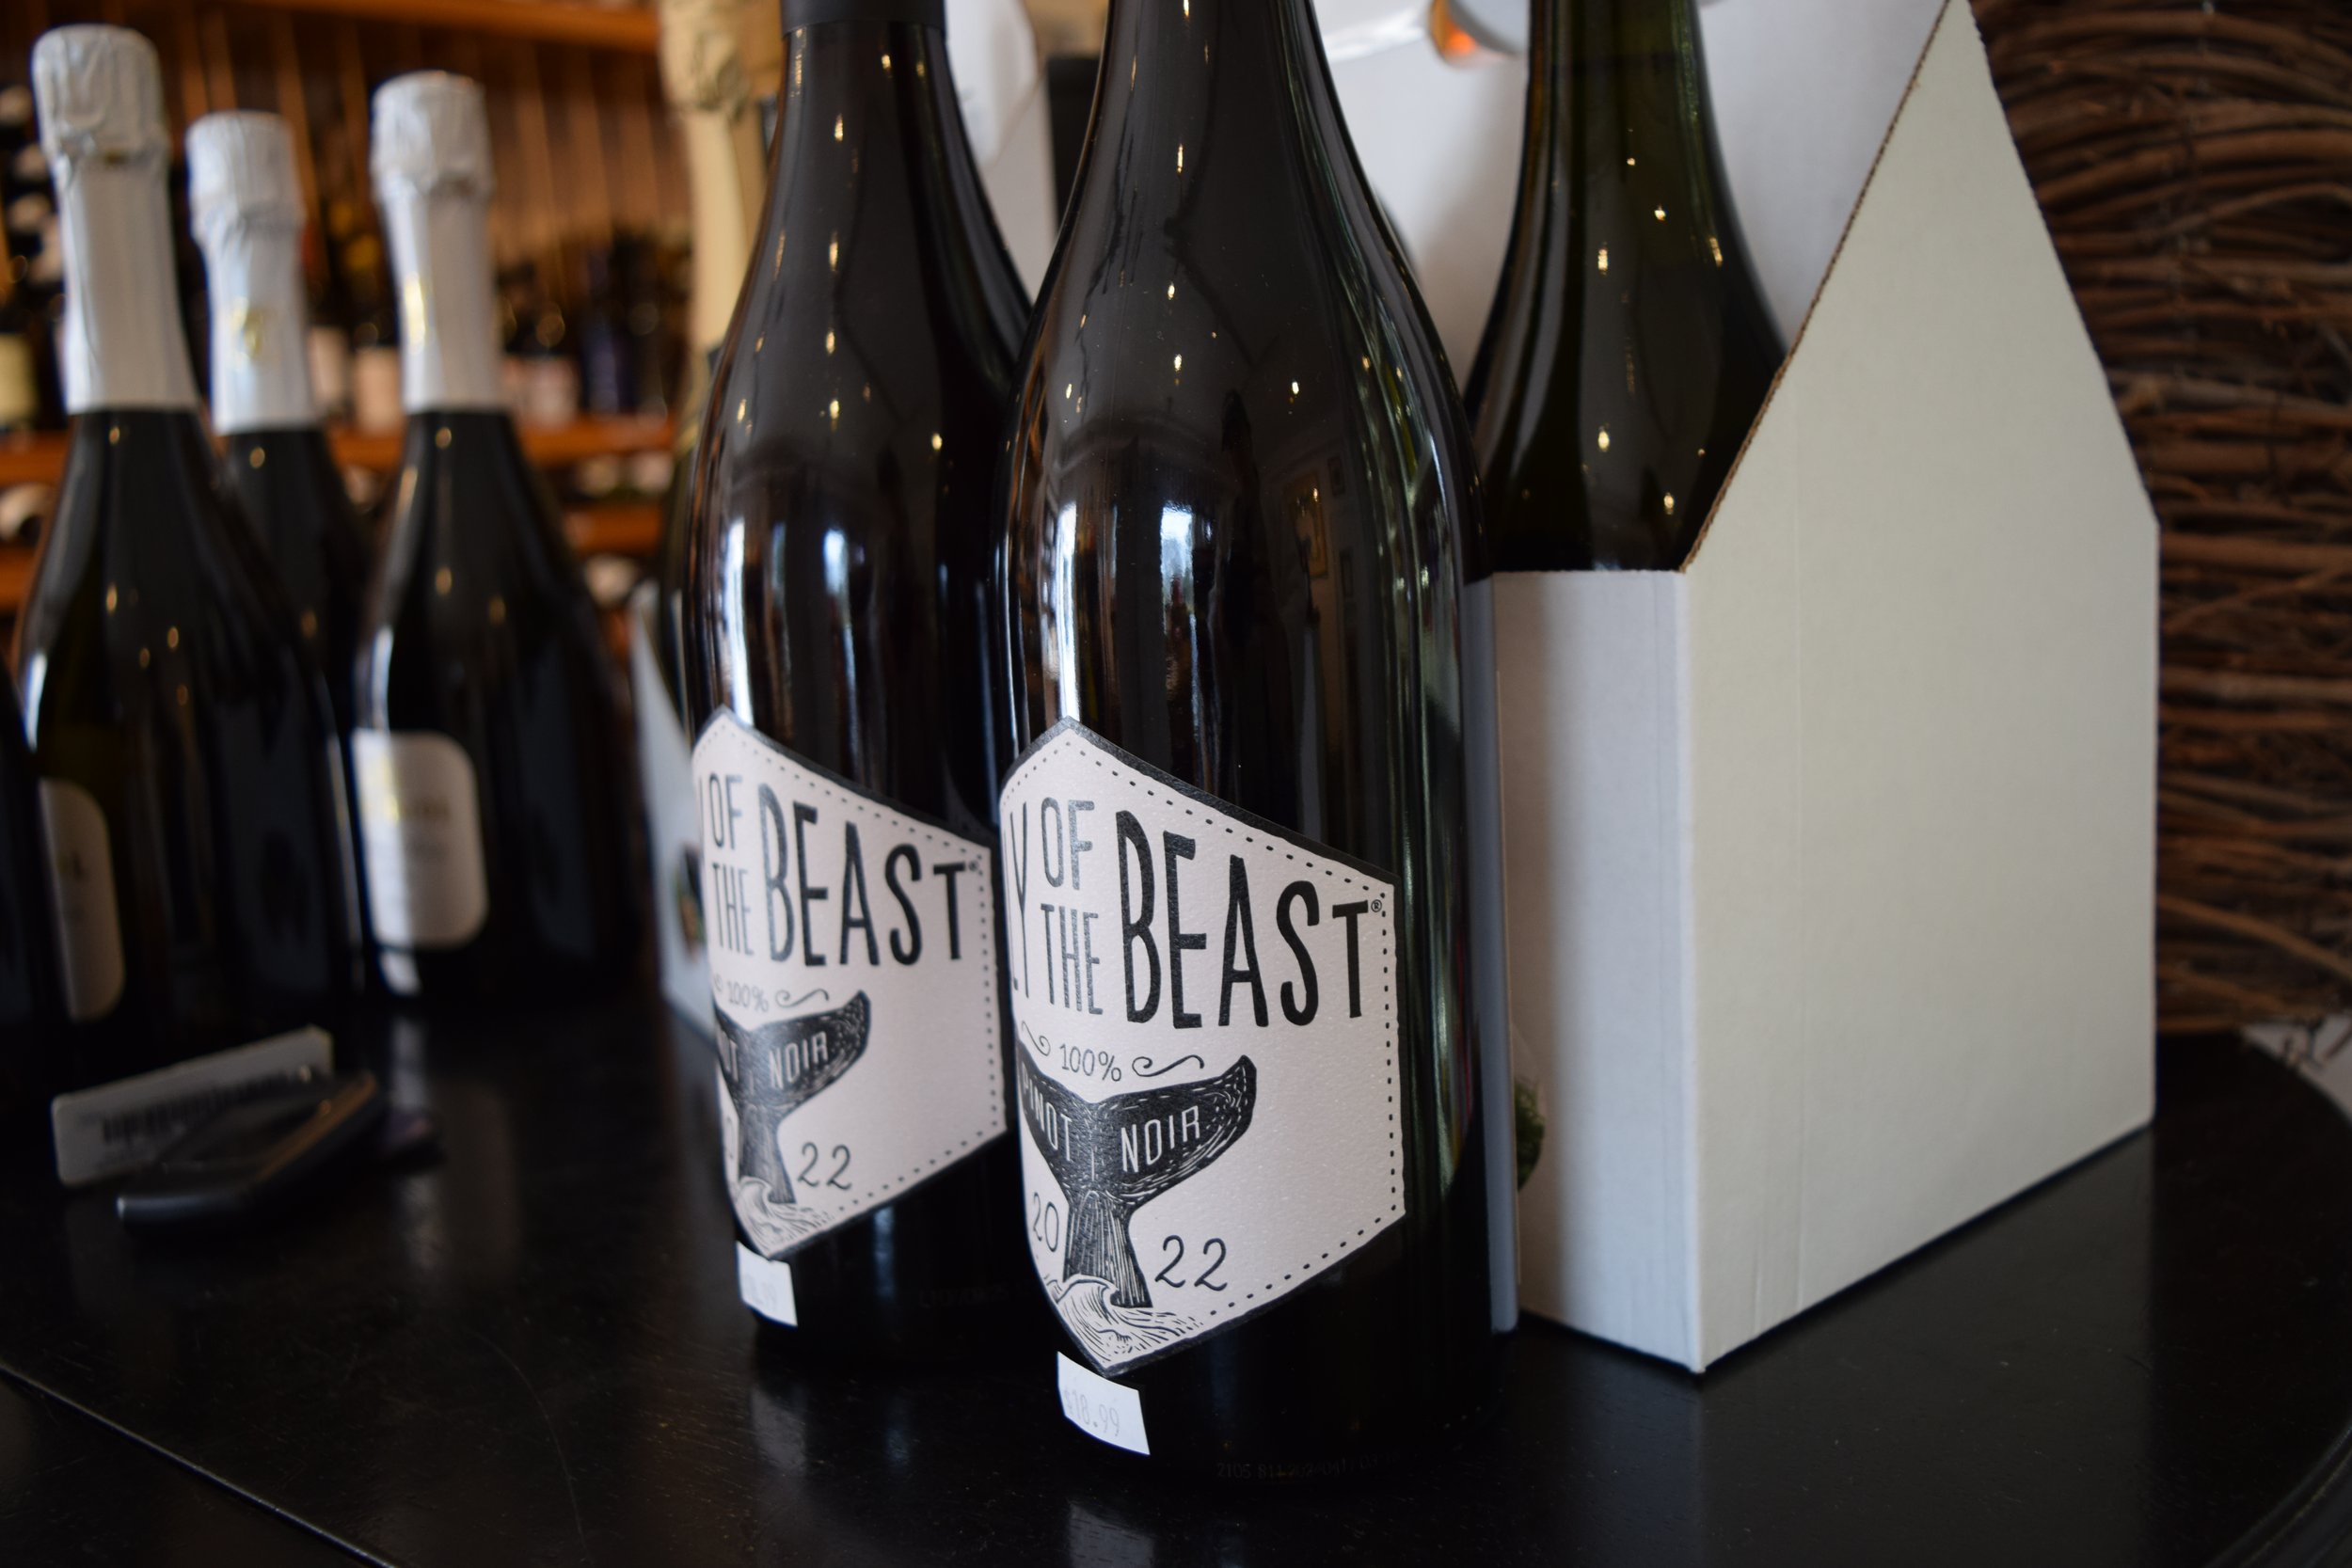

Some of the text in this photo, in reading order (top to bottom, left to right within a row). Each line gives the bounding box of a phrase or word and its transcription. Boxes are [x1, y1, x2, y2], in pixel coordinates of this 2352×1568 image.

[708, 771, 743, 851] OF
[1041, 797, 1095, 891] OF
[712, 861, 755, 958] THE
[1041, 902, 1104, 1016] THE
[727, 980, 770, 1013] 100%
[769, 1031, 829, 1089] NOIR
[1059, 1043, 1122, 1083] 100%
[1021, 1061, 1201, 1174] PINOT NOIR
[797, 1141, 853, 1192] 22
[1154, 1234, 1229, 1291] 22
